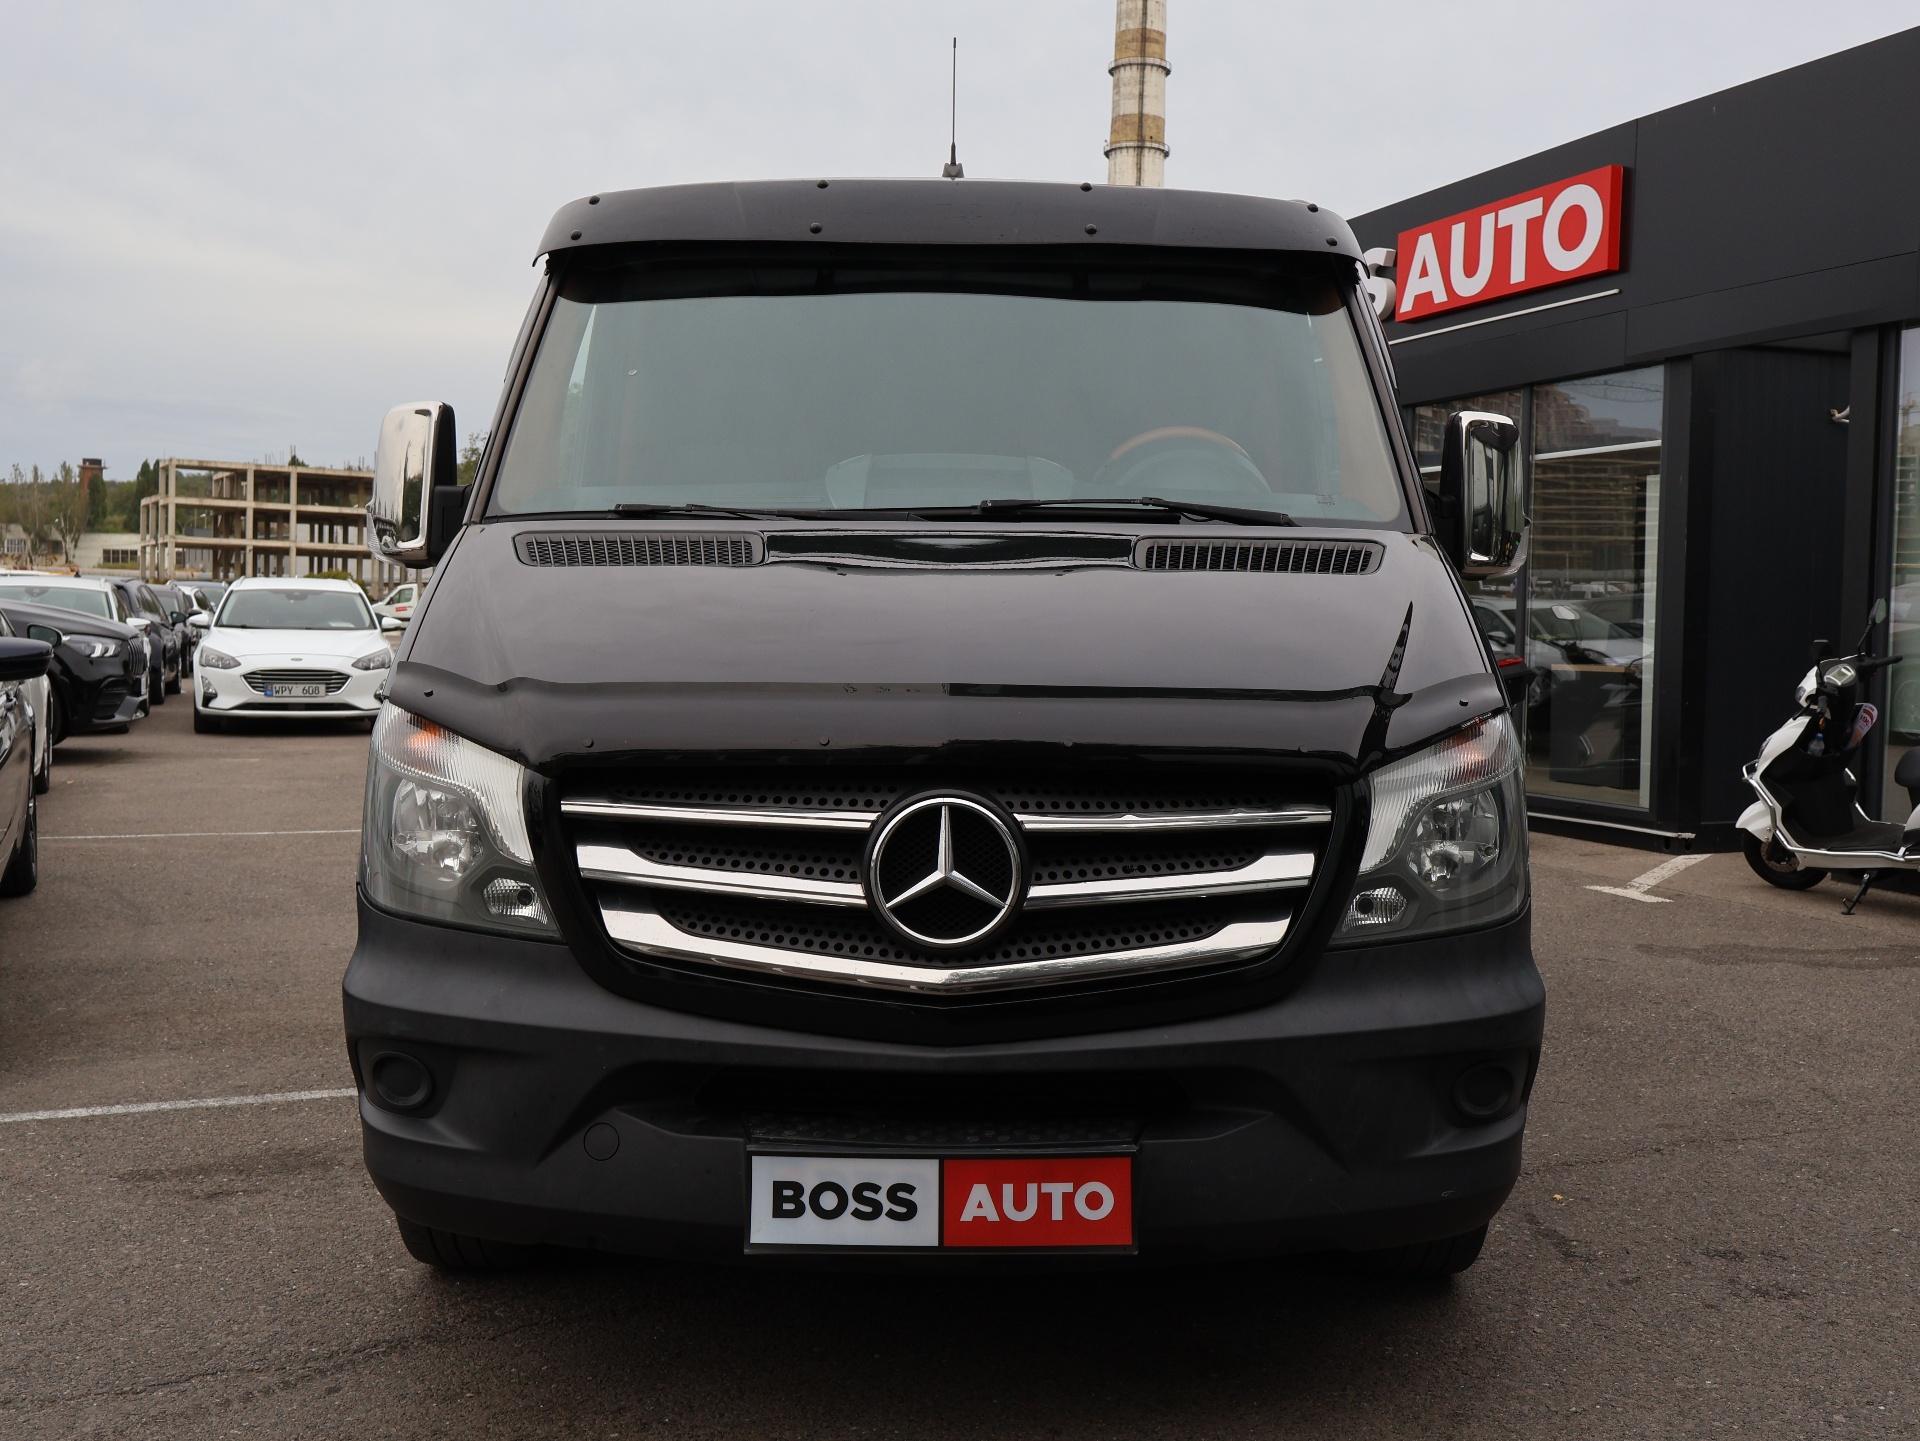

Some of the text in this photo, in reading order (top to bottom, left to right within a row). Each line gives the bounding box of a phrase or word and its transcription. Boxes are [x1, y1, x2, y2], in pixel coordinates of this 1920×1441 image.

[1400, 184, 1604, 313] AUTO
[274, 685, 320, 695] WPY 608
[772, 1180, 1115, 1222] BOSS AUTO
